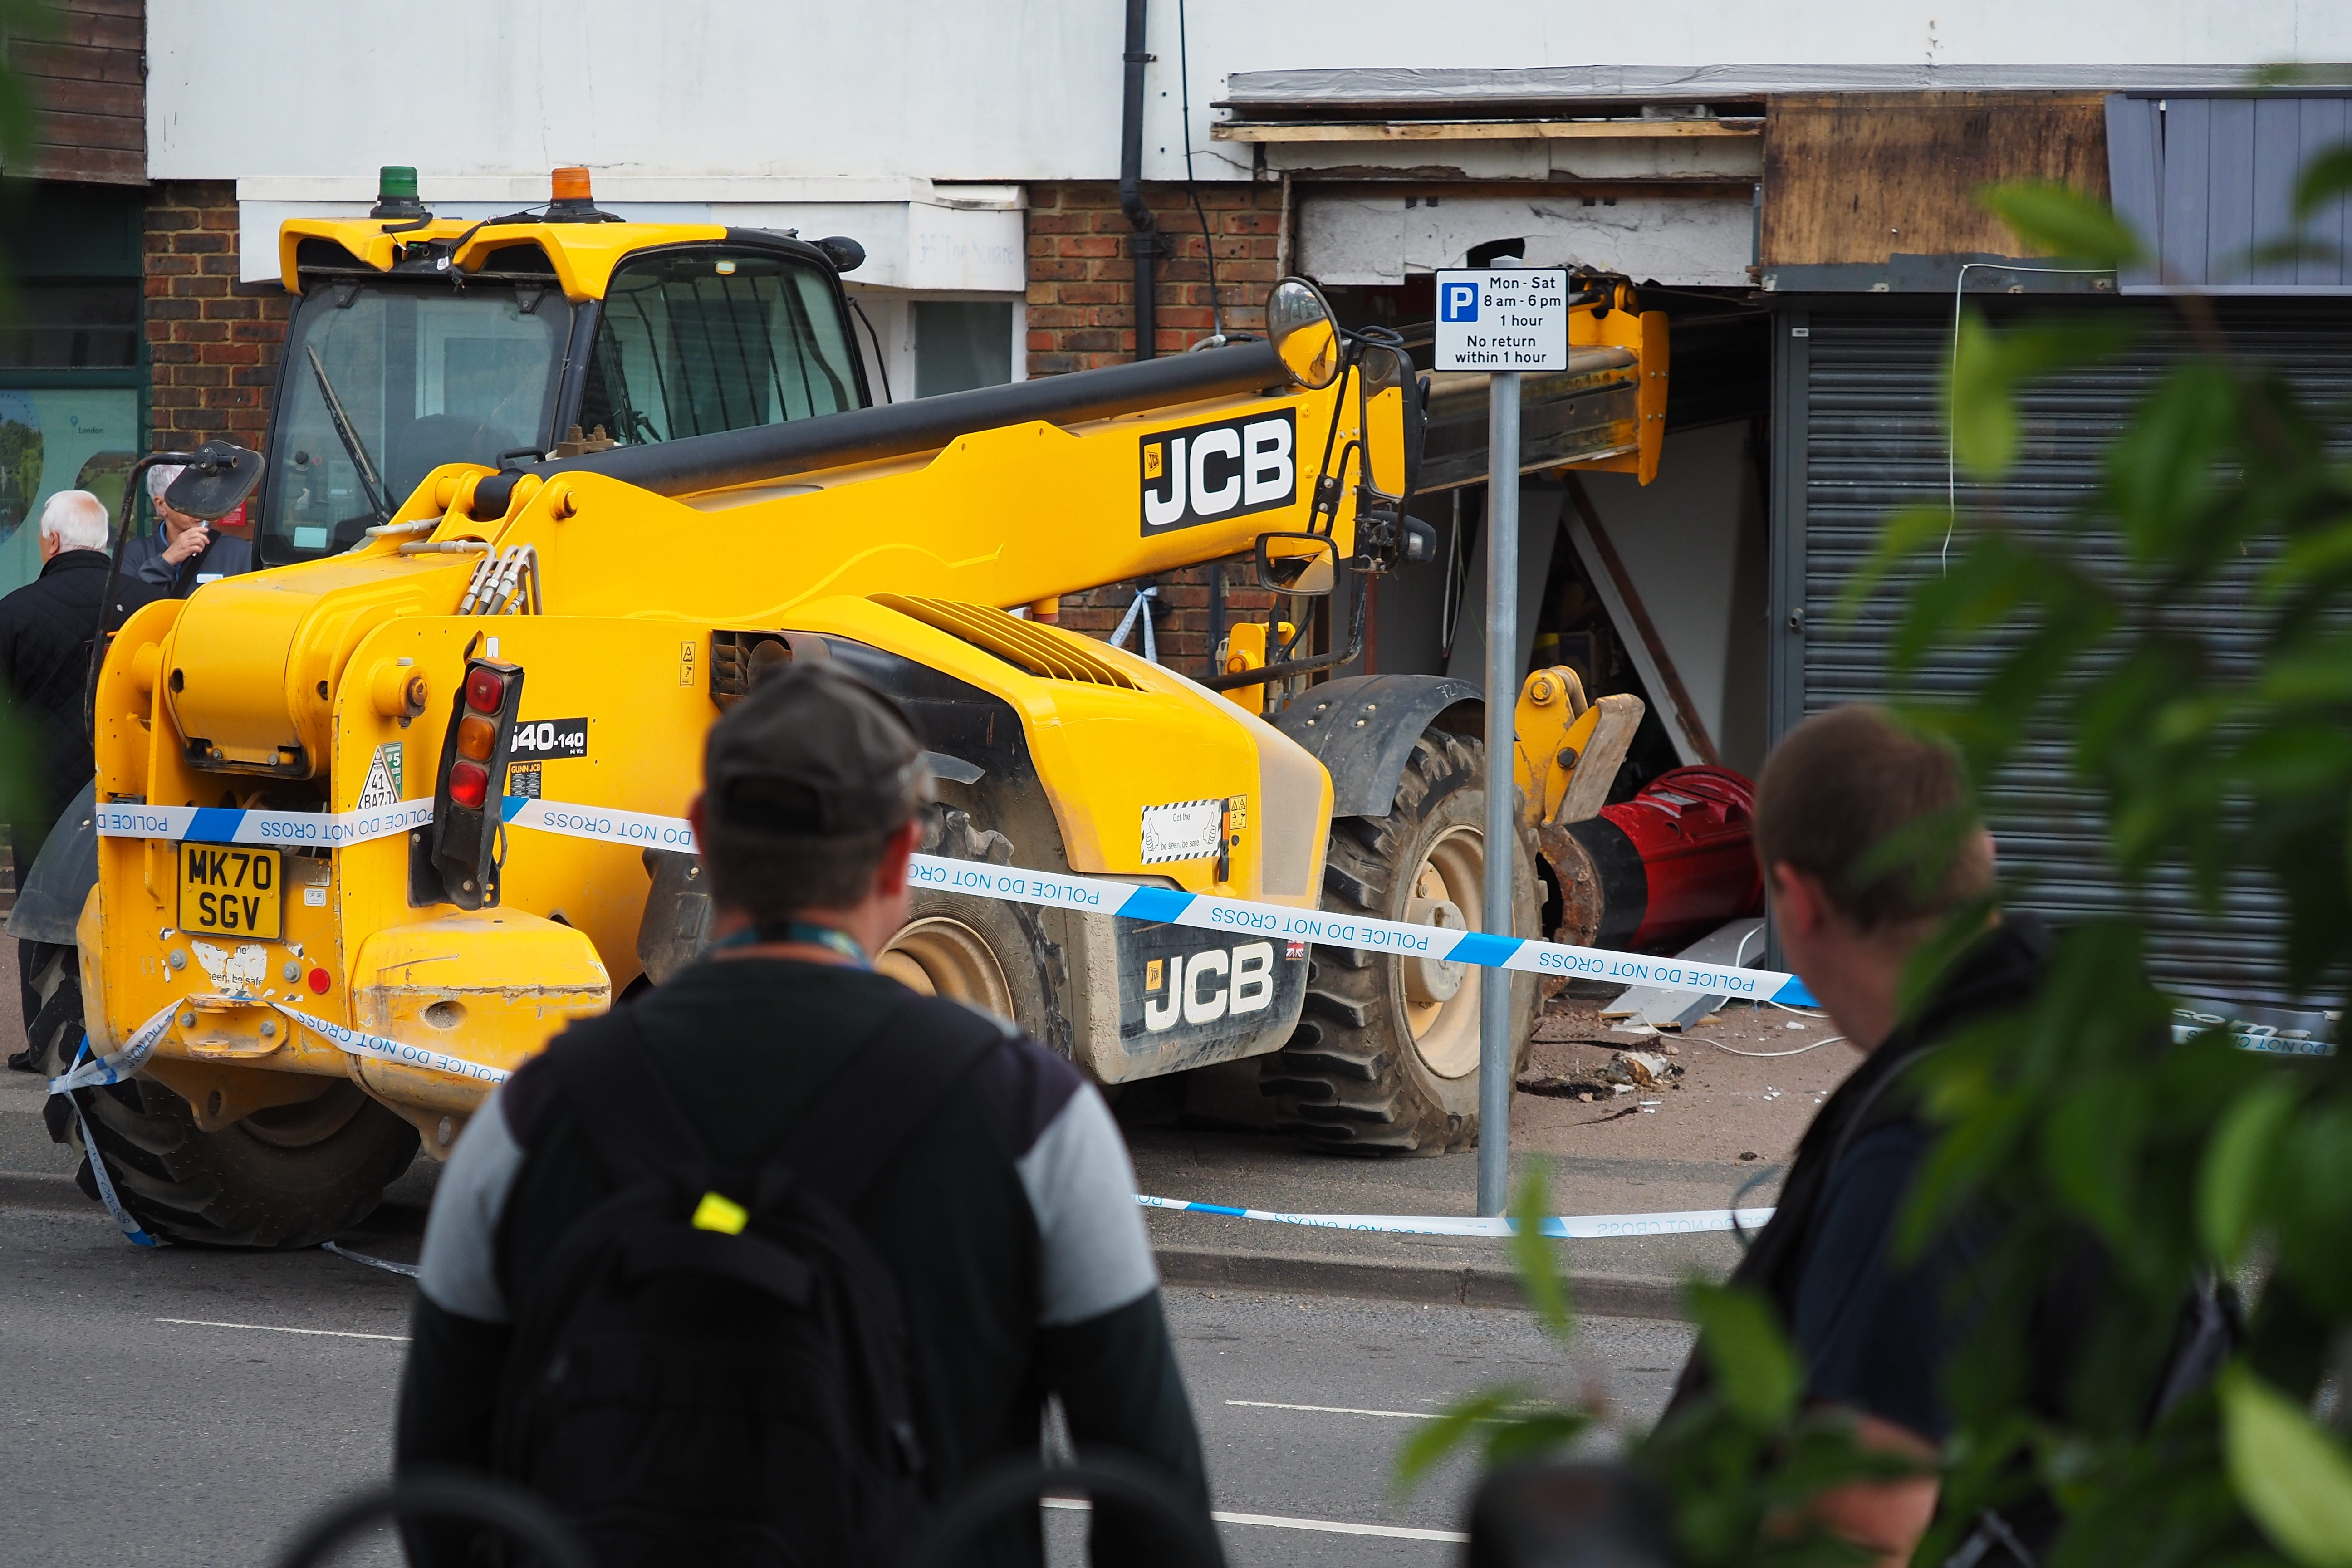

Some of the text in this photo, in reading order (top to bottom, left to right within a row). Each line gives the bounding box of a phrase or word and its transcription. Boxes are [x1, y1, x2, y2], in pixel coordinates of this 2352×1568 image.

[1490, 277, 1519, 289] Mon
[1531, 277, 1555, 289] Sat
[1450, 287, 1473, 318] P
[1484, 295, 1492, 306] 8
[1496, 298, 1516, 306] am
[1529, 295, 1536, 306] 6
[1541, 298, 1561, 309] pm
[1501, 315, 1543, 326] 1 hour
[1467, 336, 1536, 347] No return
[1455, 352, 1547, 363] within 1 hour
[1148, 453, 1159, 470] JCB
[1145, 418, 1293, 525] JCB
[393, 753, 400, 766] 5
[511, 765, 529, 773] GUNN
[372, 774, 384, 790] 41
[111, 814, 167, 832] POLICE
[1173, 813, 1181, 822] Get
[261, 821, 316, 838] CROSS
[321, 823, 353, 840] NOT
[358, 818, 380, 835] DO
[544, 812, 691, 846] DO NOT CROSS
[1189, 838, 1201, 847] safe!
[189, 849, 272, 890] MK70
[907, 863, 1100, 905] POLICE DO NOT CRO
[199, 892, 260, 931] SGV
[1211, 907, 1429, 951] POLICE DO NOT CROSS
[1150, 968, 1159, 982] JCB
[1540, 952, 1755, 992] POLICE DO NOT CROSS
[1145, 942, 1274, 1031] JCB
[296, 1011, 351, 1043] CROSS
[356, 1034, 397, 1055] NOT
[2255, 1038, 2295, 1053] NOT
[402, 1046, 430, 1065] DO
